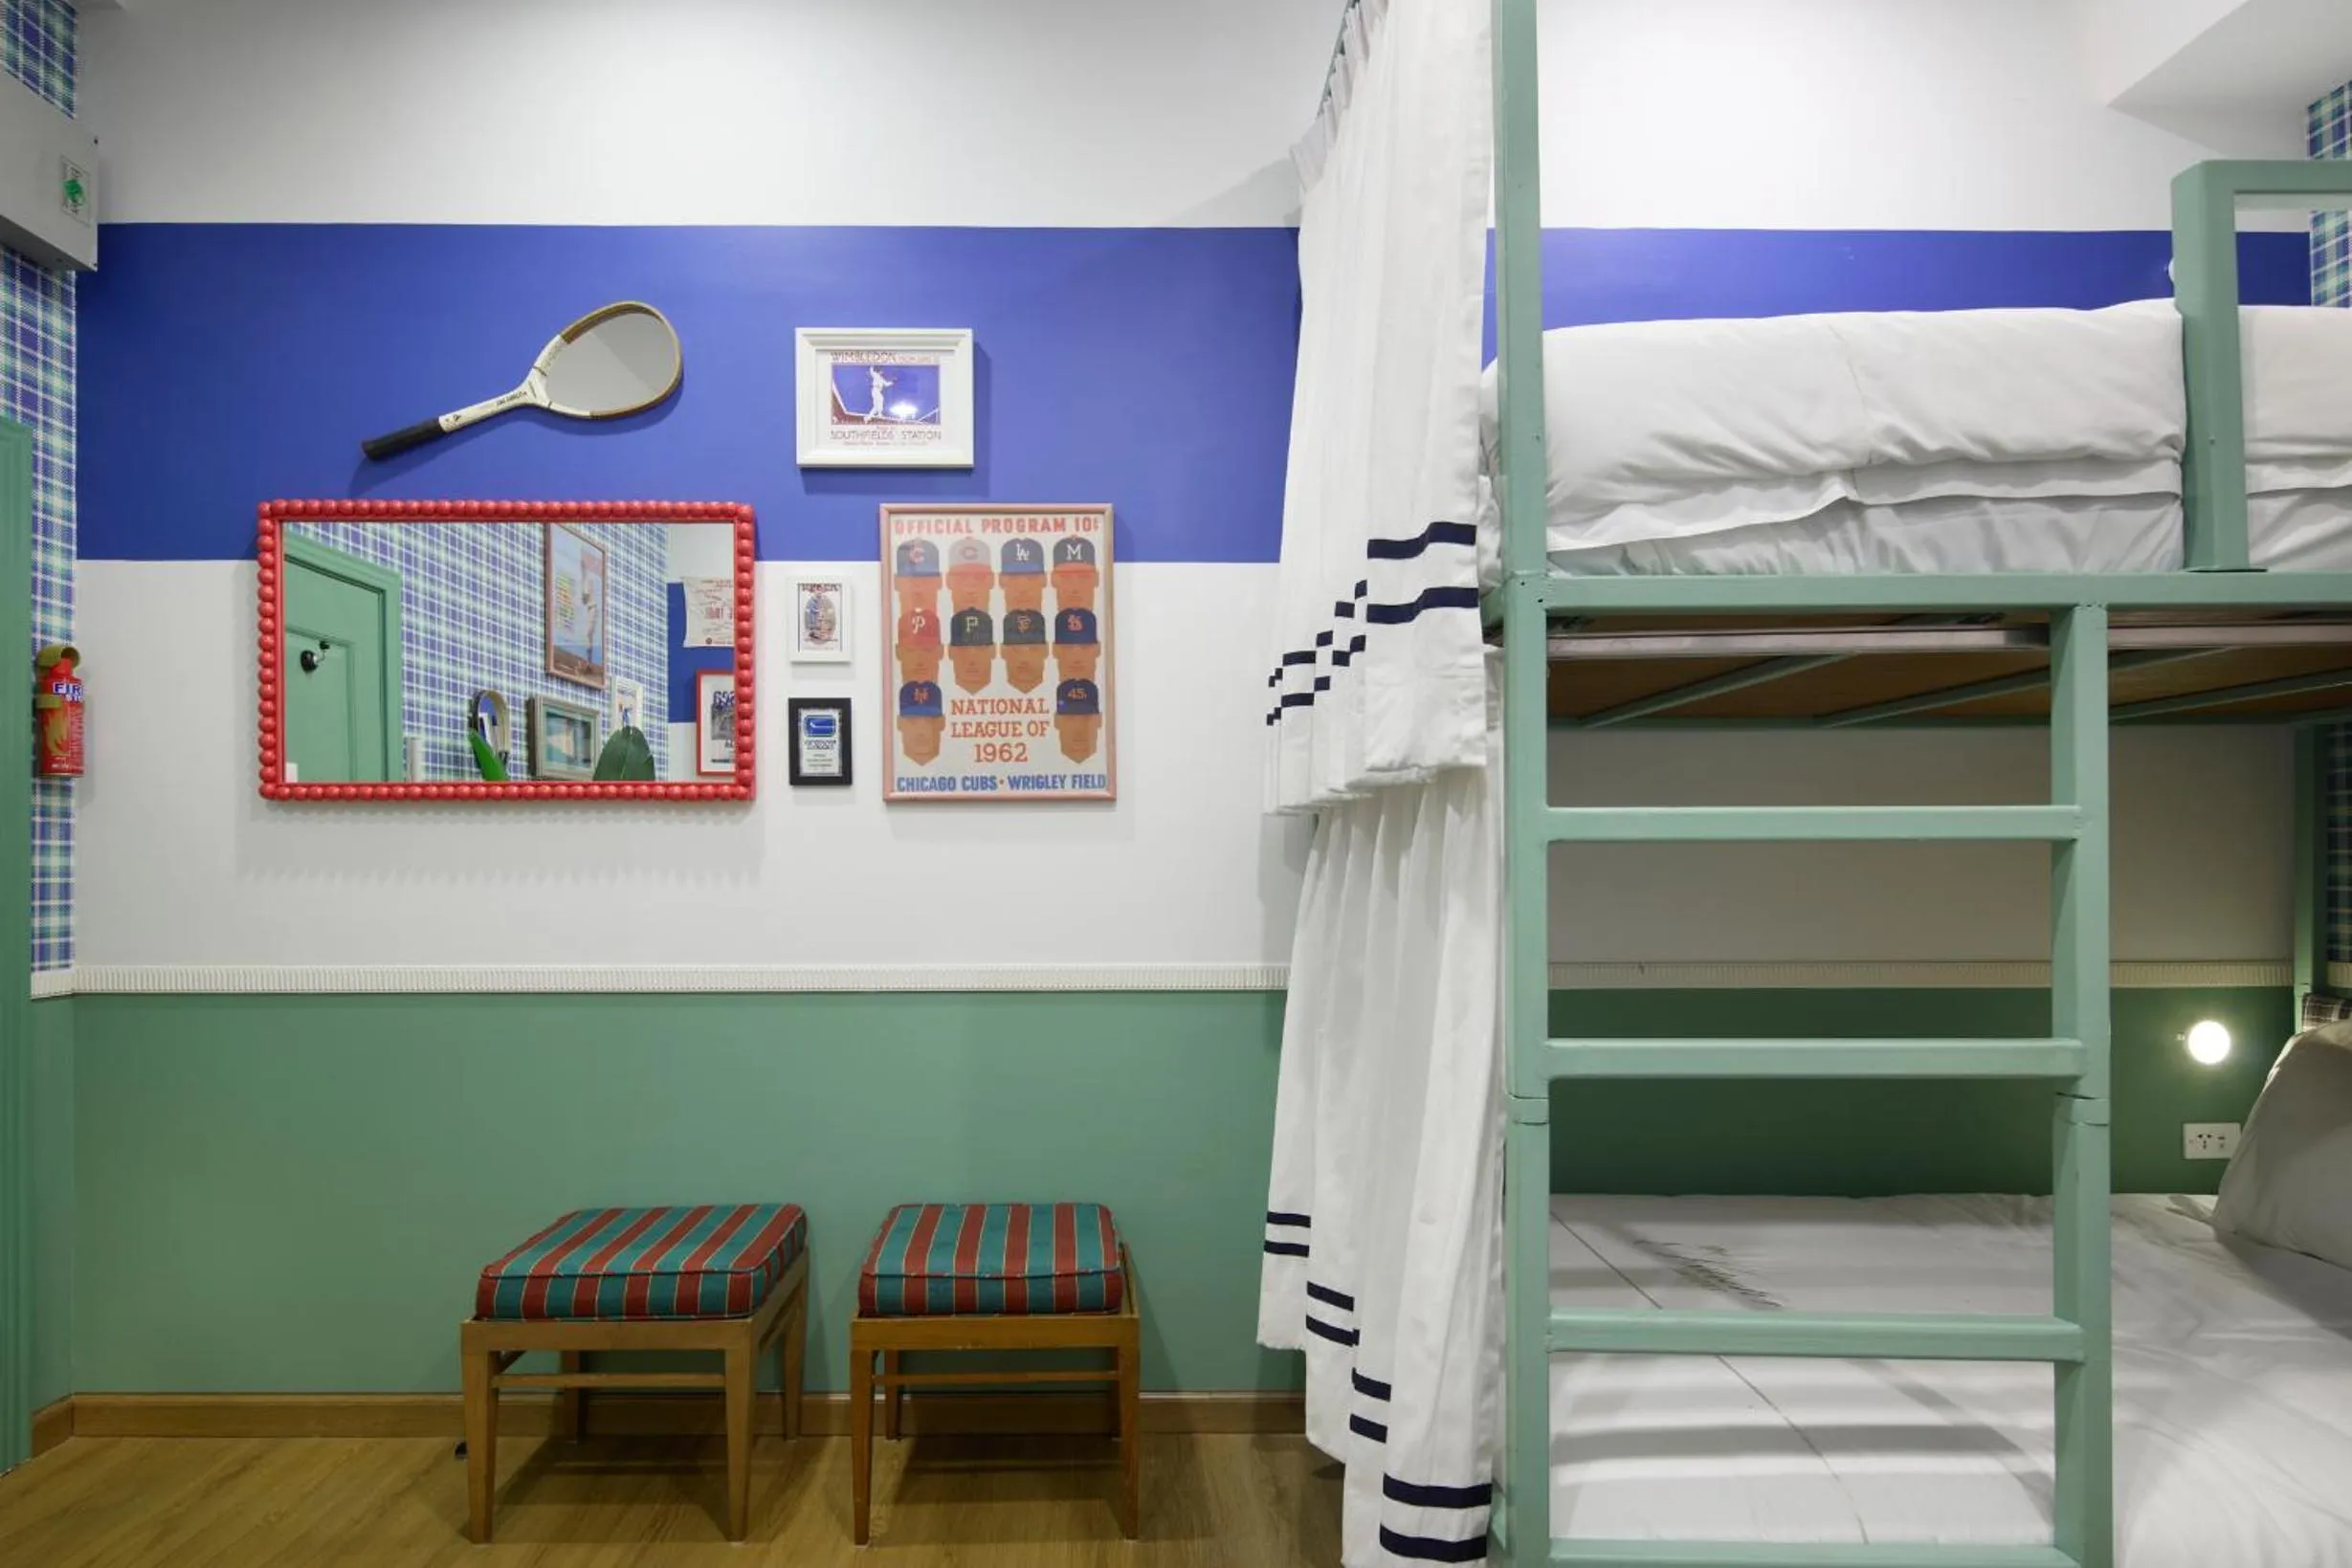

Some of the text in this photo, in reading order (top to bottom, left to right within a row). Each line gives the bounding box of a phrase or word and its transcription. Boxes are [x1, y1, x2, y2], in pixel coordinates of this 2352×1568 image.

[901, 430, 942, 440] STATION
[894, 519, 974, 535] OFFICIAL
[982, 518, 1066, 534] PROGRAM
[962, 546, 978, 561] C
[1066, 542, 1082, 562] M
[965, 615, 980, 633] P
[54, 683, 84, 696] FIR
[950, 698, 1050, 716] NATIONAL
[950, 720, 1050, 738] LEAGUE OF
[973, 741, 1029, 763] 1962
[897, 773, 1108, 792] CHICAGO CUBS WRIGLEY FIELD
